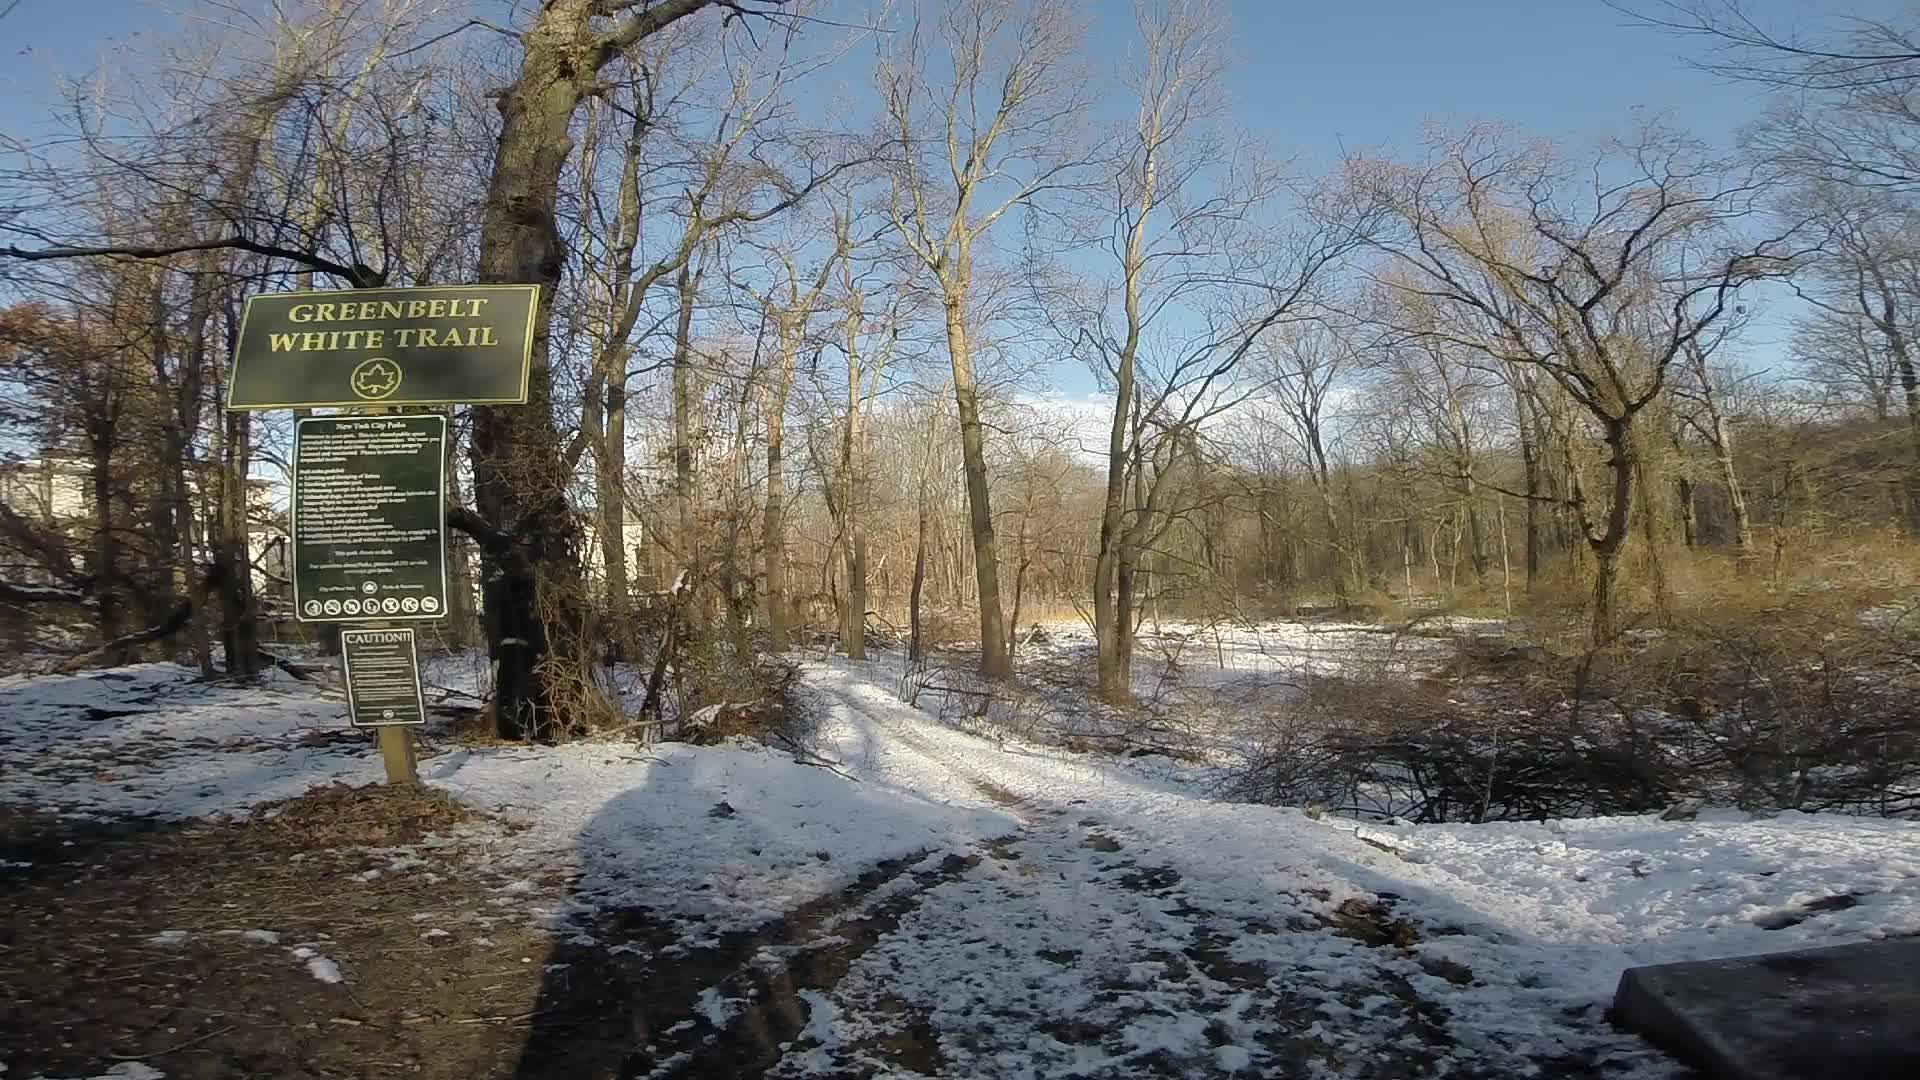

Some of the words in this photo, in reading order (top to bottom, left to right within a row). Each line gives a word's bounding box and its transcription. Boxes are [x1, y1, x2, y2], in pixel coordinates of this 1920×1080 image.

[288, 298, 489, 323] GREENBELT
[268, 329, 385, 353] WHITE
[393, 326, 499, 350] TRAIL
